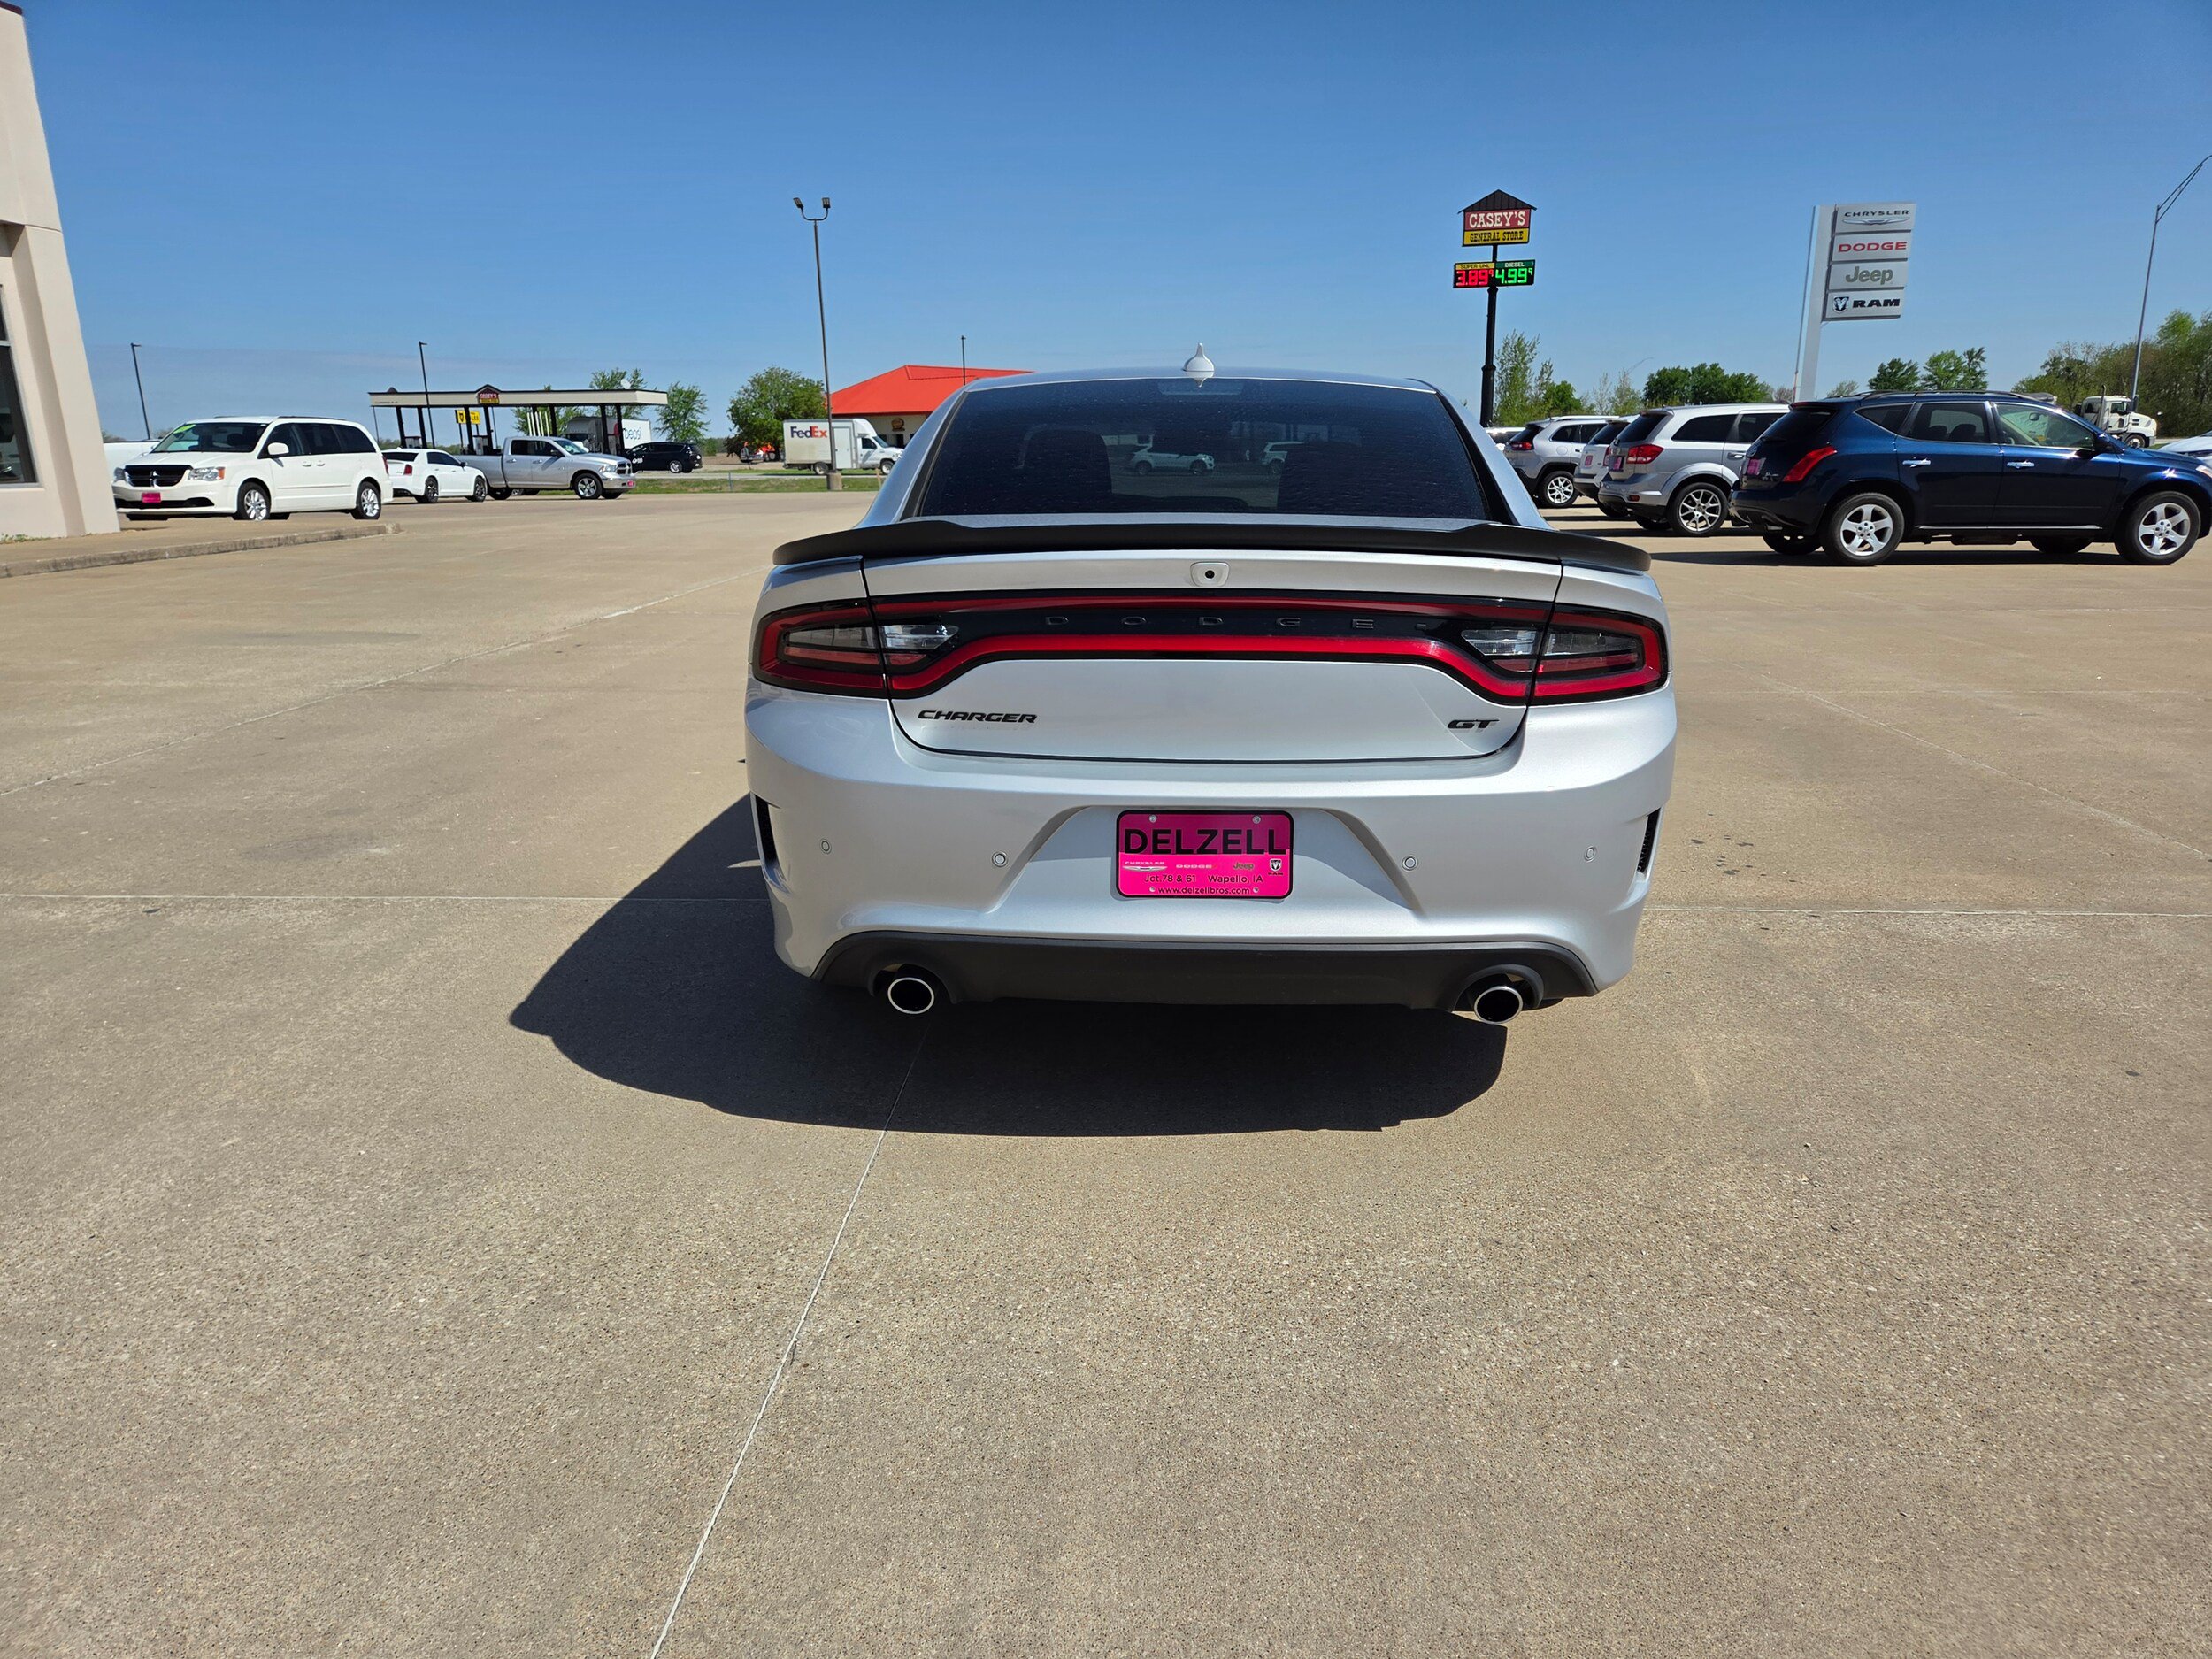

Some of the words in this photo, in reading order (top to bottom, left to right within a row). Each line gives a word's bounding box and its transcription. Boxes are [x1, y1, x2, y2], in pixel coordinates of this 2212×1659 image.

[1469, 211, 1525, 227] CASEY'S
[1470, 232, 1500, 242] GENERAL
[1502, 230, 1524, 241] STORE
[1838, 242, 1908, 253] DODGE
[1845, 265, 1893, 286] Jeep
[1852, 298, 1901, 309] RAM
[790, 426, 827, 439] FedEx
[1046, 616, 1375, 629] DODGE
[918, 710, 1038, 724] CHARGER
[1447, 718, 1501, 729] GT
[1125, 828, 1287, 856] DELZELL
[1233, 862, 1255, 871] Jeep
[1176, 874, 1183, 883] &
[1186, 874, 1195, 883] 61
[1208, 874, 1250, 885] Wapello,
[1253, 874, 1263, 883] IA
